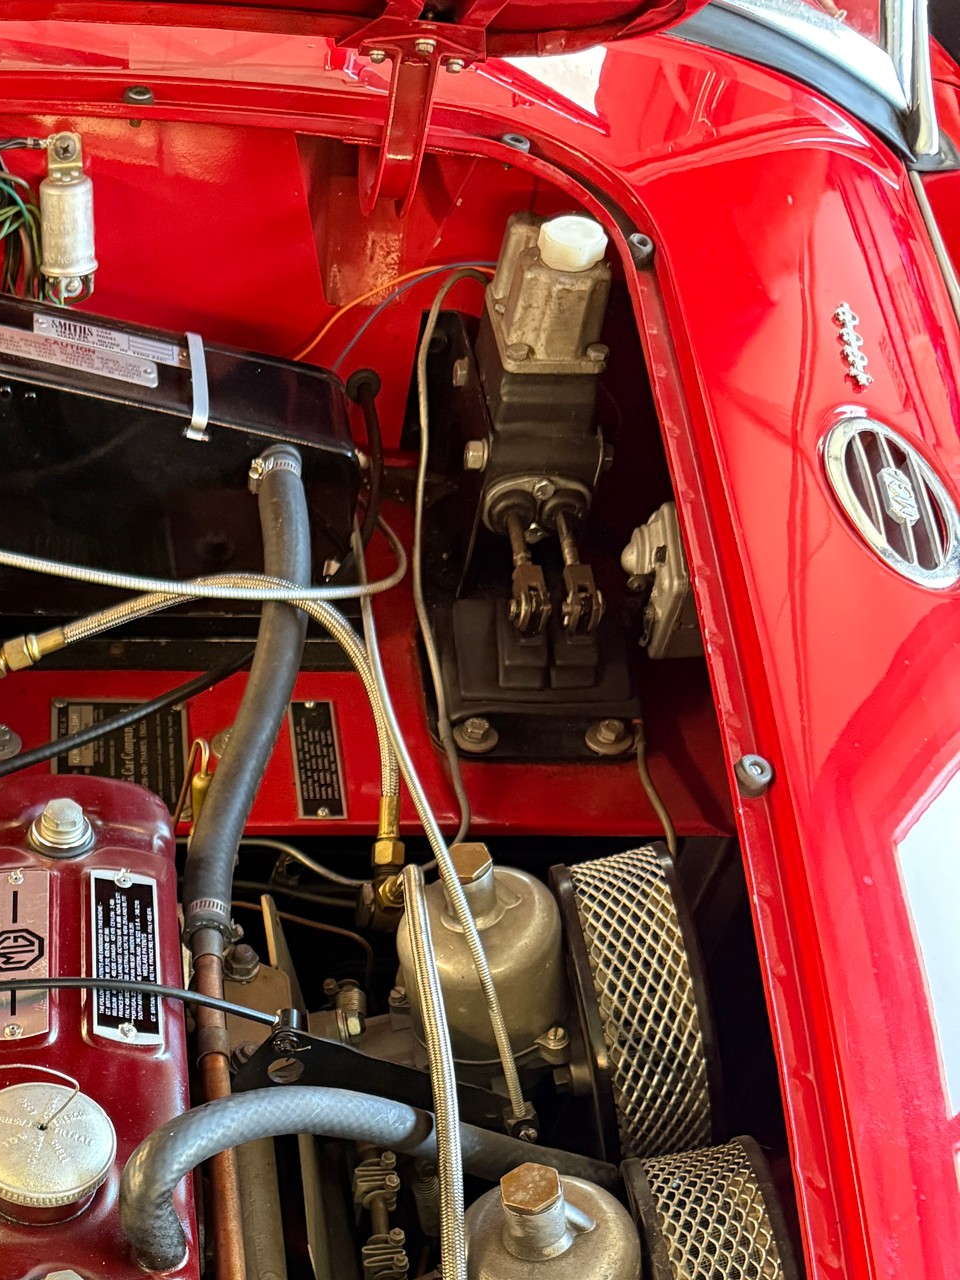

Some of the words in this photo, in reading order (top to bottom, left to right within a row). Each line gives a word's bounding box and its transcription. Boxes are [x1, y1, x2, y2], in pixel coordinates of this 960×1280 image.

[51, 319, 94, 338] SMITHS
[44, 338, 96, 355] CAUTION
[121, 760, 134, 774] Car
[48, 1138, 70, 1167] SHELL
